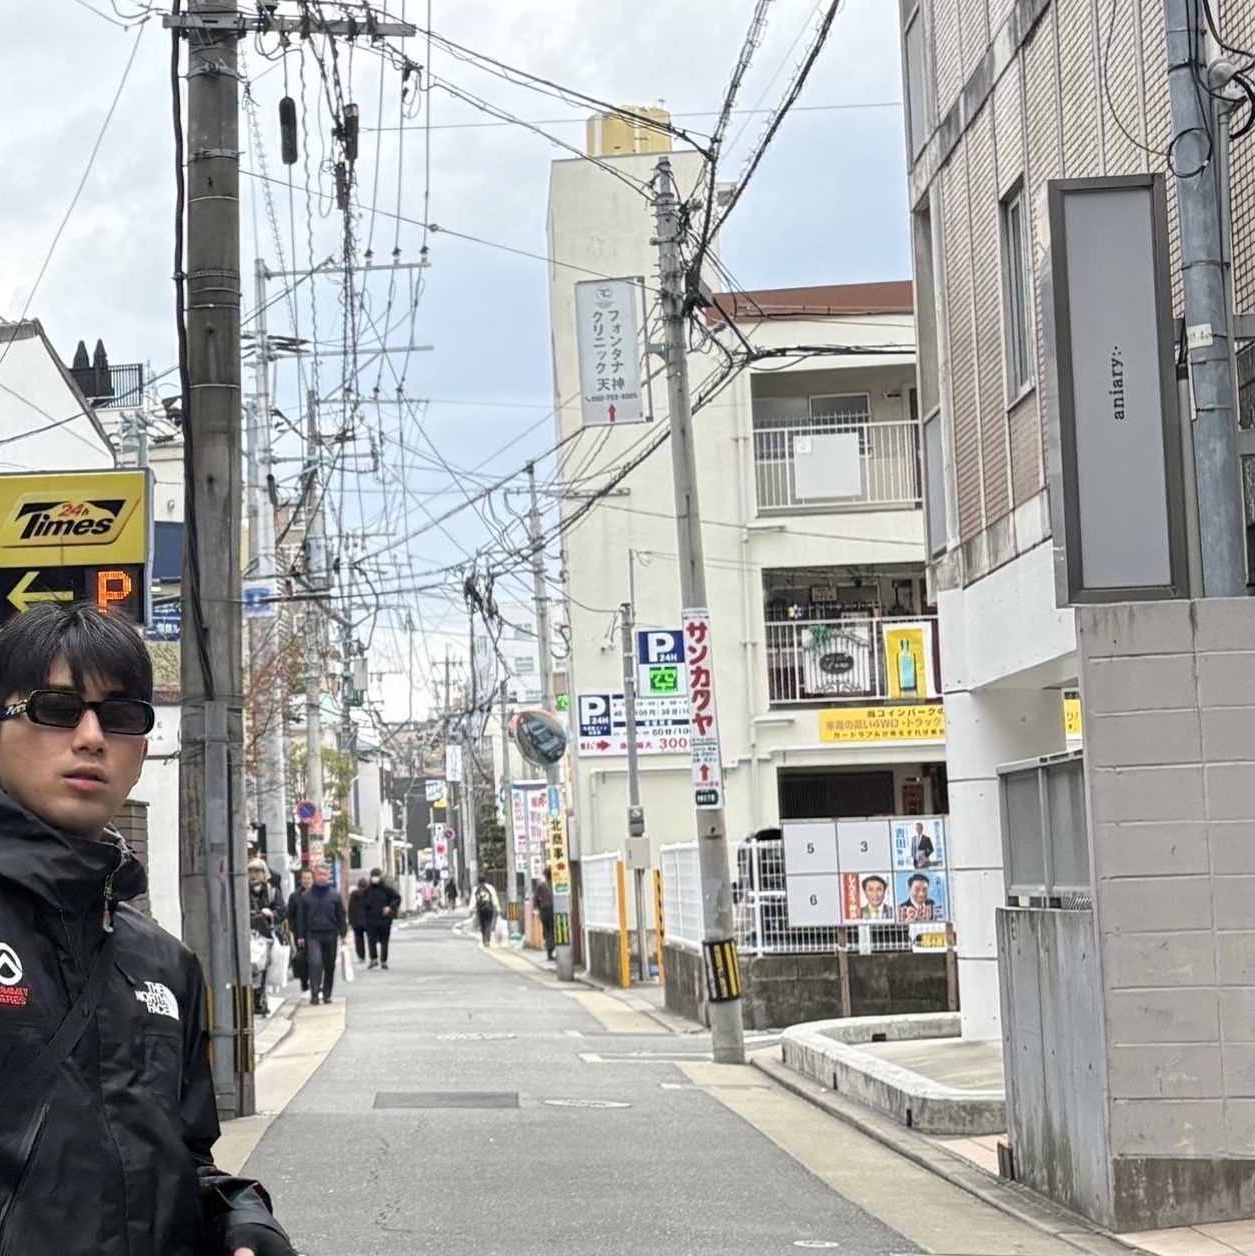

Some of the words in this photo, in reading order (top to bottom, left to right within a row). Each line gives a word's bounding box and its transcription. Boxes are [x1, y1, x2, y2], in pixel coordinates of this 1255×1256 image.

[592, 311, 606, 375] クリニック
[608, 310, 624, 374] フォンタナ
[597, 377, 625, 391] 天神
[19, 509, 114, 541] Times
[98, 571, 132, 613] P
[647, 632, 674, 663] P
[659, 653, 678, 662] 24H
[580, 697, 606, 725] P
[591, 716, 609, 725] 24H
[659, 738, 691, 750] 300
[807, 842, 815, 854] 5
[860, 841, 868, 852] 3
[809, 894, 818, 905] 6
[144, 981, 165, 994] THE
[134, 990, 167, 1005] NORTH
[147, 1001, 170, 1016] FACE
